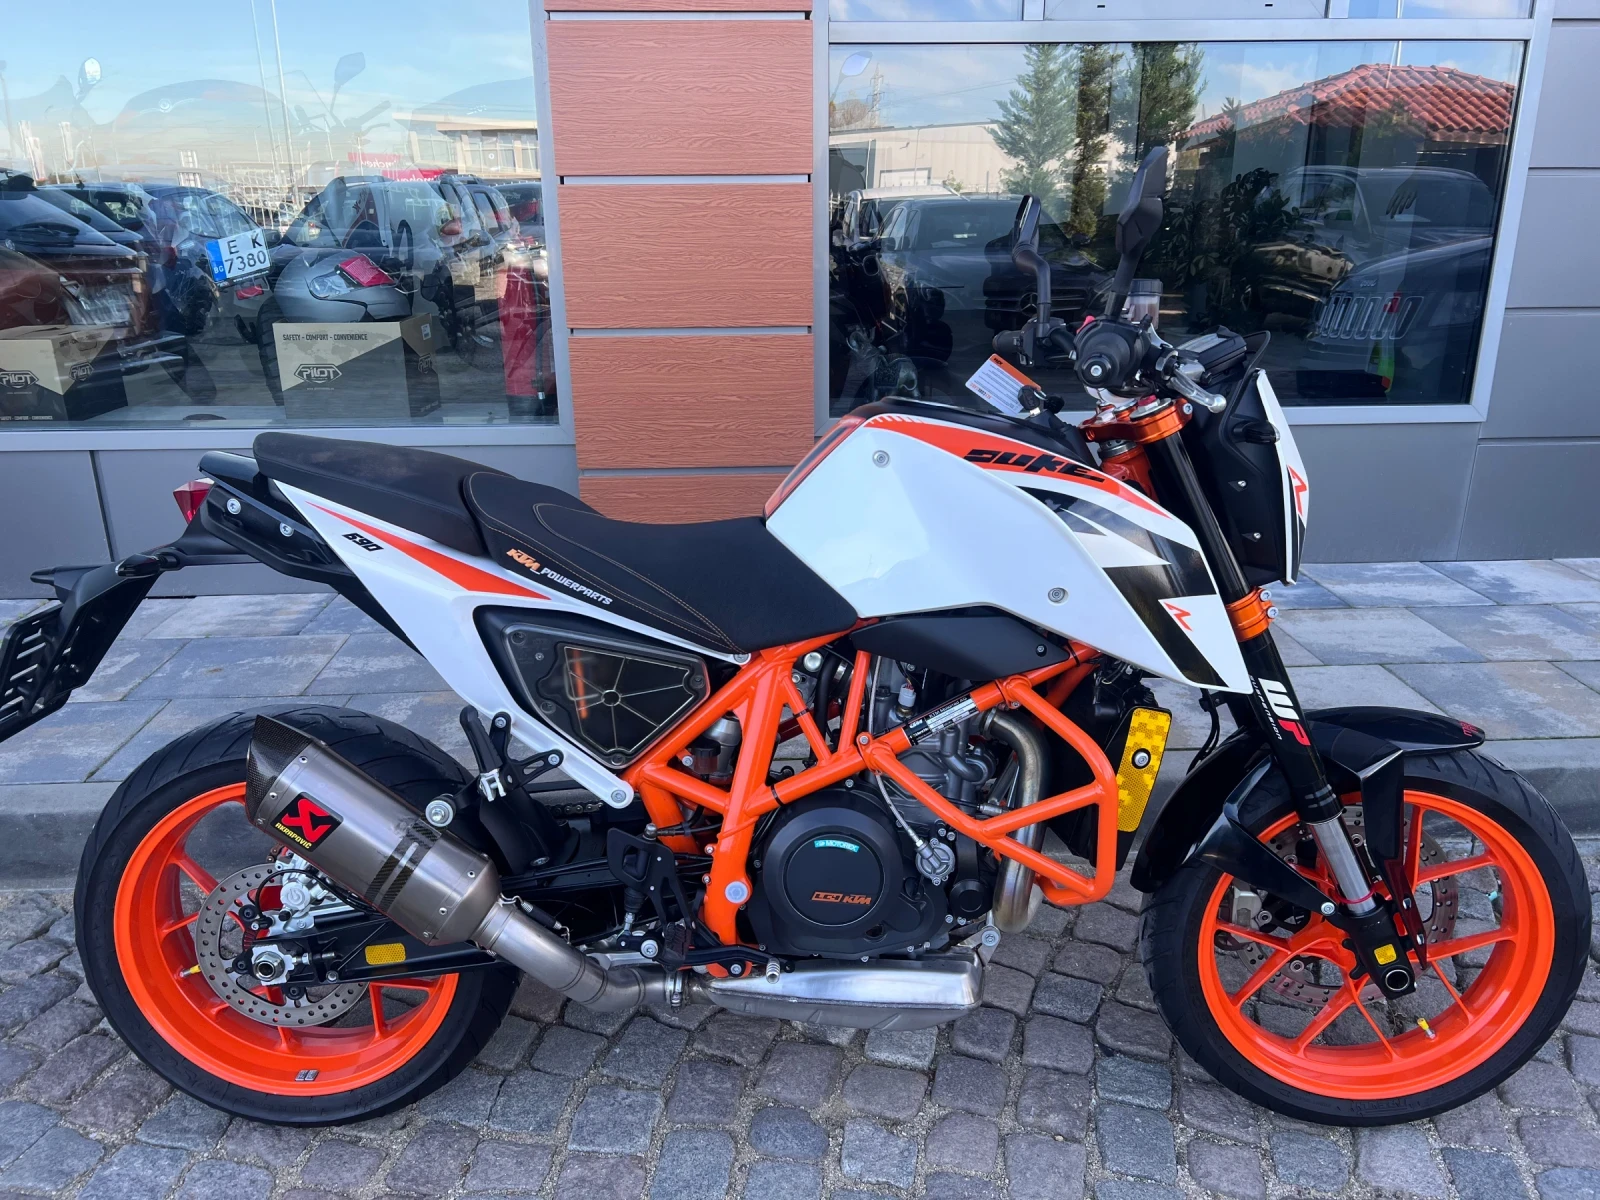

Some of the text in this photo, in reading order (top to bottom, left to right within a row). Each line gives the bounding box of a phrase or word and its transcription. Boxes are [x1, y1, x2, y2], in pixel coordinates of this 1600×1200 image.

[227, 232, 263, 255] E K
[213, 265, 224, 274] BG
[224, 250, 267, 274] 7380
[282, 333, 301, 341] SAFETY
[305, 333, 329, 341] COMFORT
[333, 333, 368, 341] CONVENIENCE
[963, 448, 1105, 483] DUKE
[342, 532, 384, 552] 690
[506, 548, 613, 605] KTM POWERPARTS
[842, 894, 872, 905] KTM
